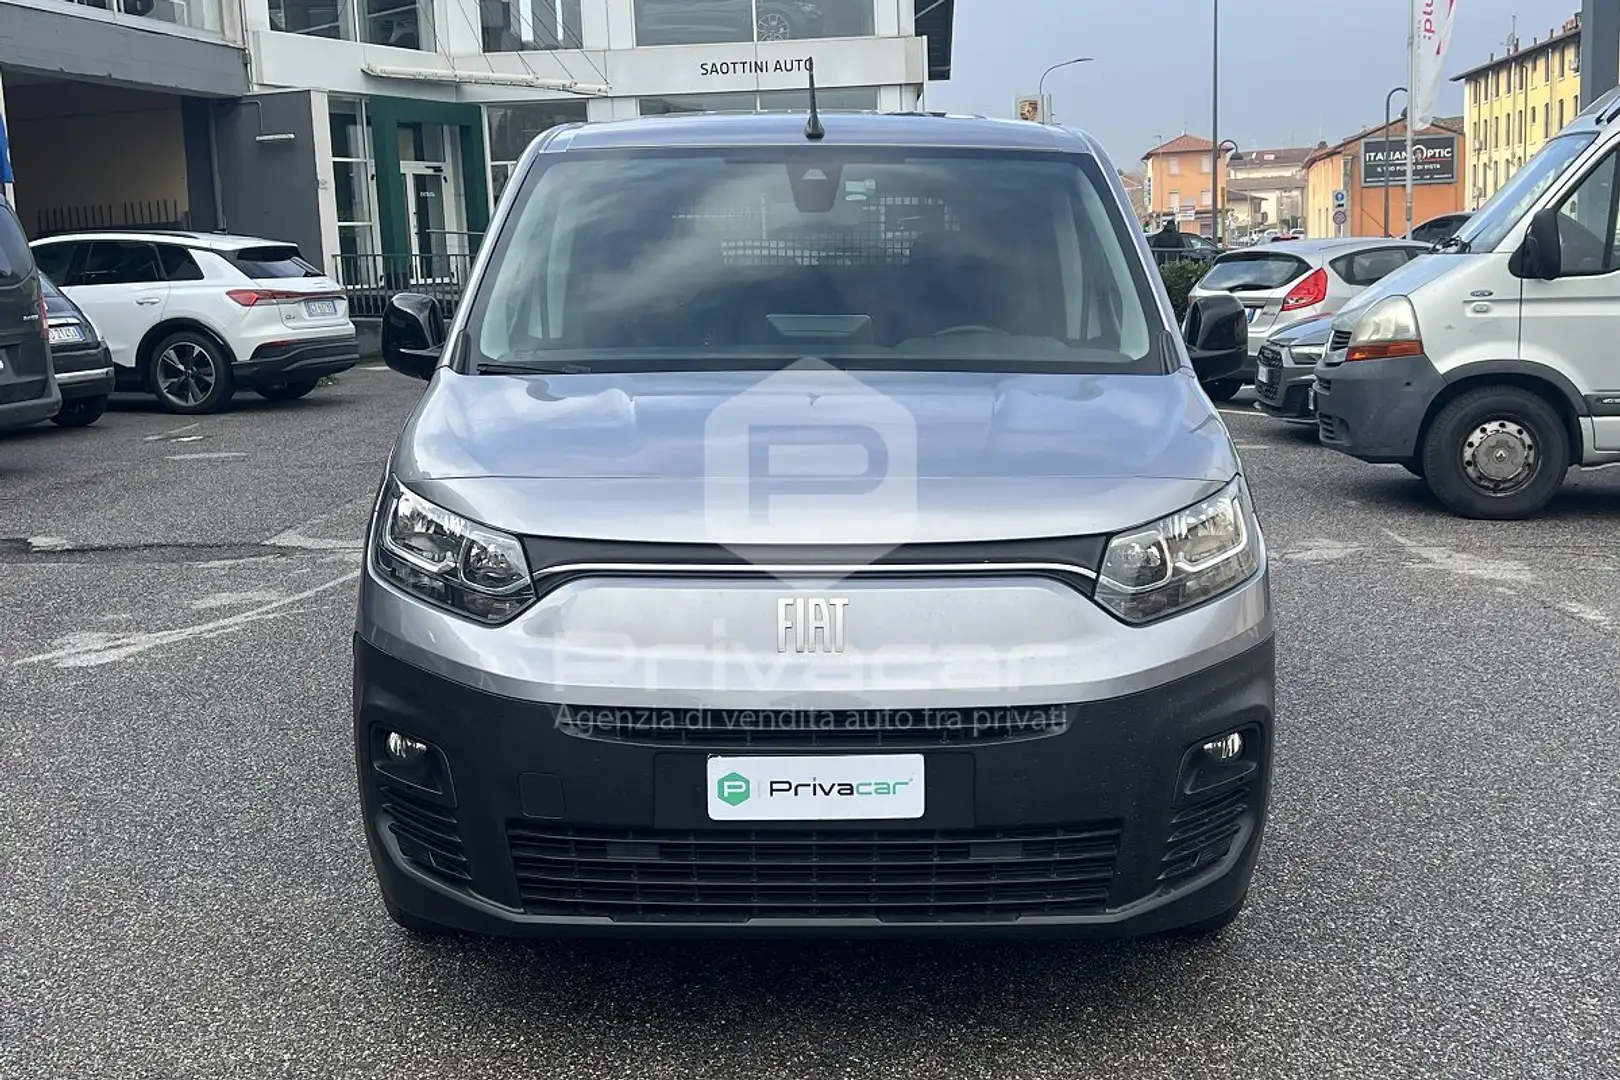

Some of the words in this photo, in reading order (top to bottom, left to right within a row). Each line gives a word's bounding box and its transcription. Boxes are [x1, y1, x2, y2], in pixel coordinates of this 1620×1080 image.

[700, 60, 768, 75] SAOTTINI
[777, 597, 850, 653] FIAT
[769, 777, 909, 797] Privacar
